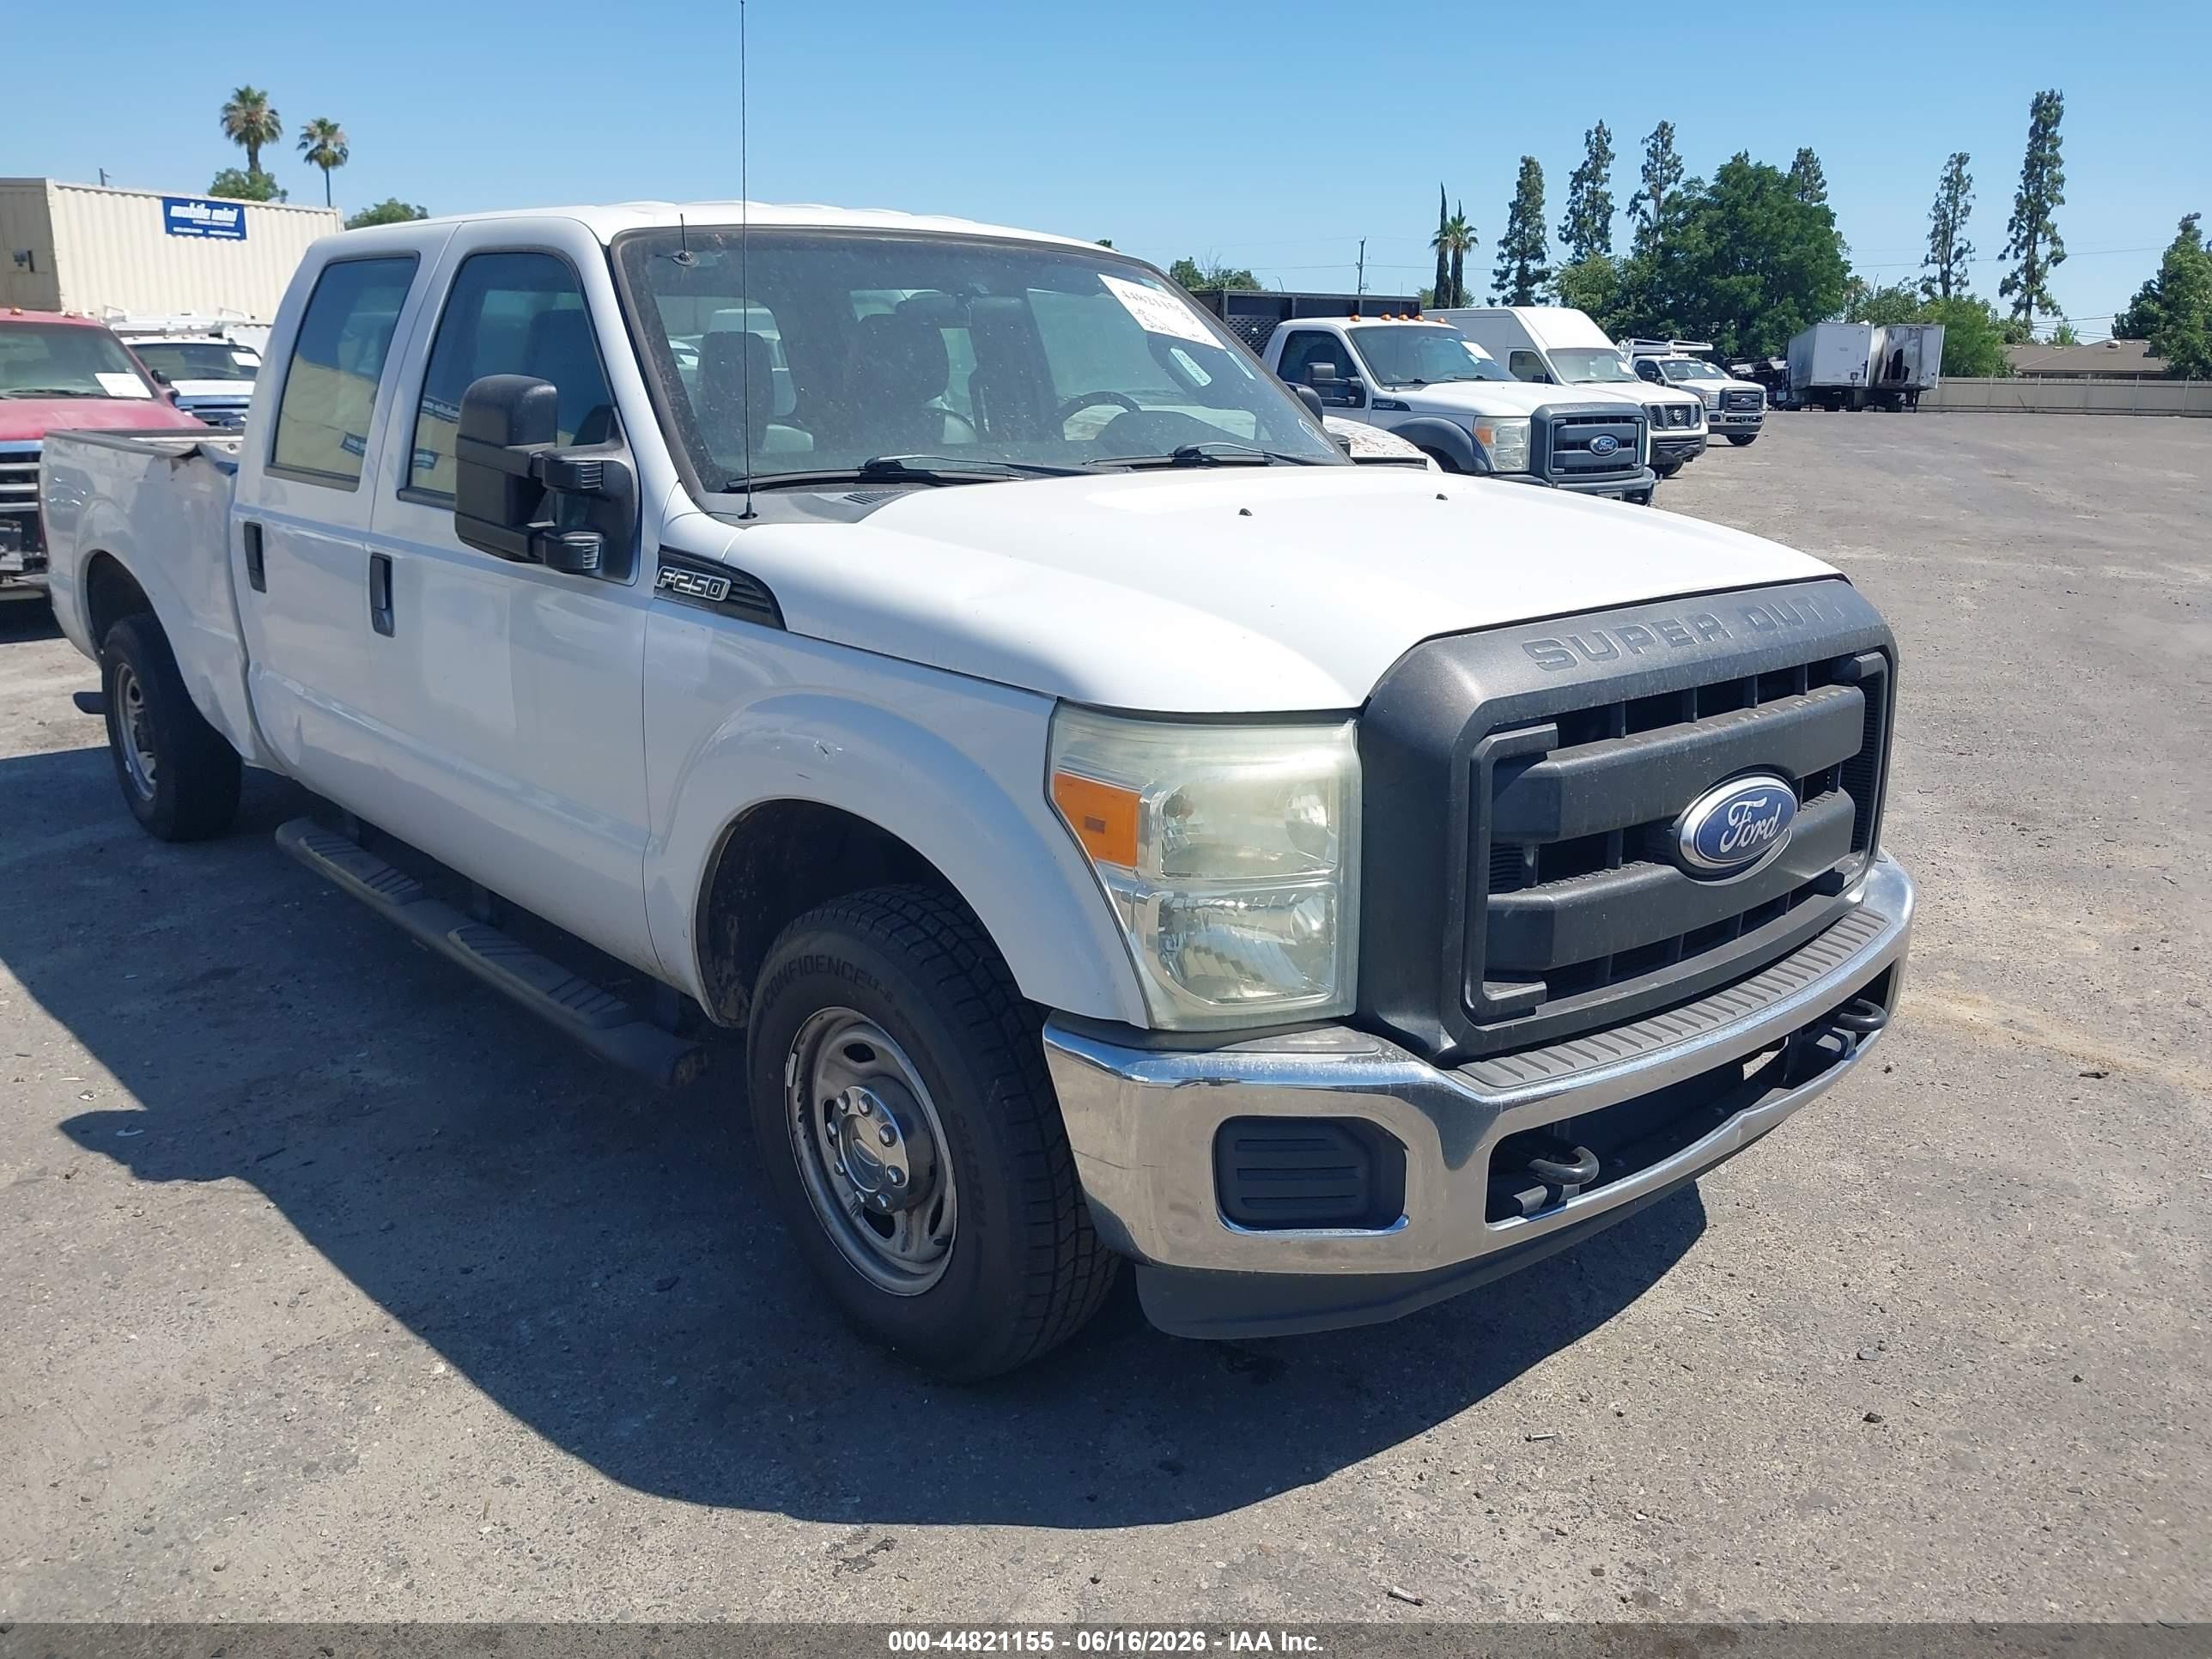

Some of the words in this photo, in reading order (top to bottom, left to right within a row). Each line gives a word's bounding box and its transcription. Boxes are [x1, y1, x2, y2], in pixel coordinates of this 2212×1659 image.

[171, 202, 210, 219] mobile
[211, 208, 239, 222] mini
[654, 565, 732, 602] F-250
[1522, 613, 1734, 672] SUPER
[1719, 796, 1783, 854] Ford
[762, 954, 866, 1009] CONFIDENCE
